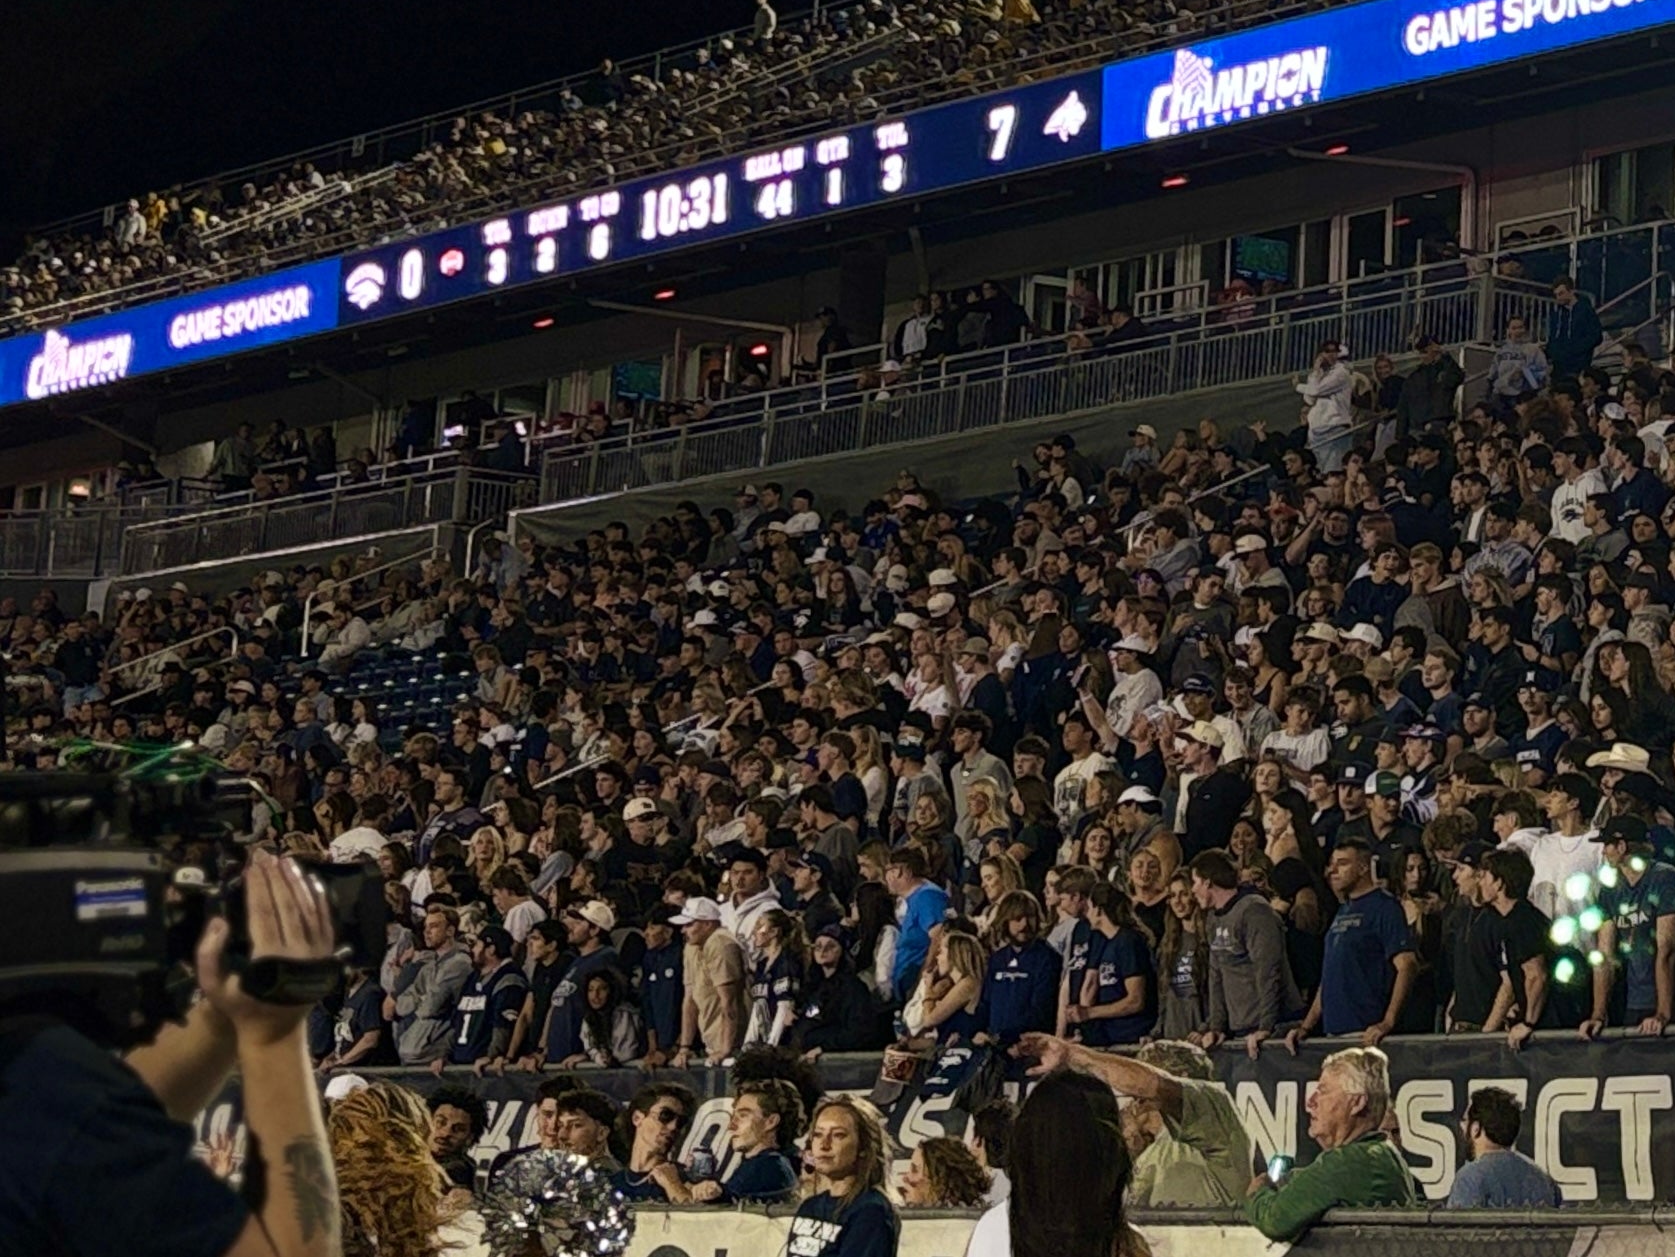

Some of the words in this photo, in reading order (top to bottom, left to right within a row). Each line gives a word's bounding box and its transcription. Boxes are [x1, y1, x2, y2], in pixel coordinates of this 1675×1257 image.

[1145, 46, 1327, 139] CHAMPION
[988, 105, 1015, 161] 7
[827, 167, 841, 205] 1
[882, 154, 904, 192] 3
[641, 173, 727, 241] 10:31
[757, 179, 793, 220] 44
[399, 249, 424, 300] 0
[487, 248, 508, 285] 3
[536, 236, 556, 273] 2
[169, 311, 222, 348] GAME
[222, 285, 310, 337] SPONSOR
[27, 329, 132, 400] CHAMPION
